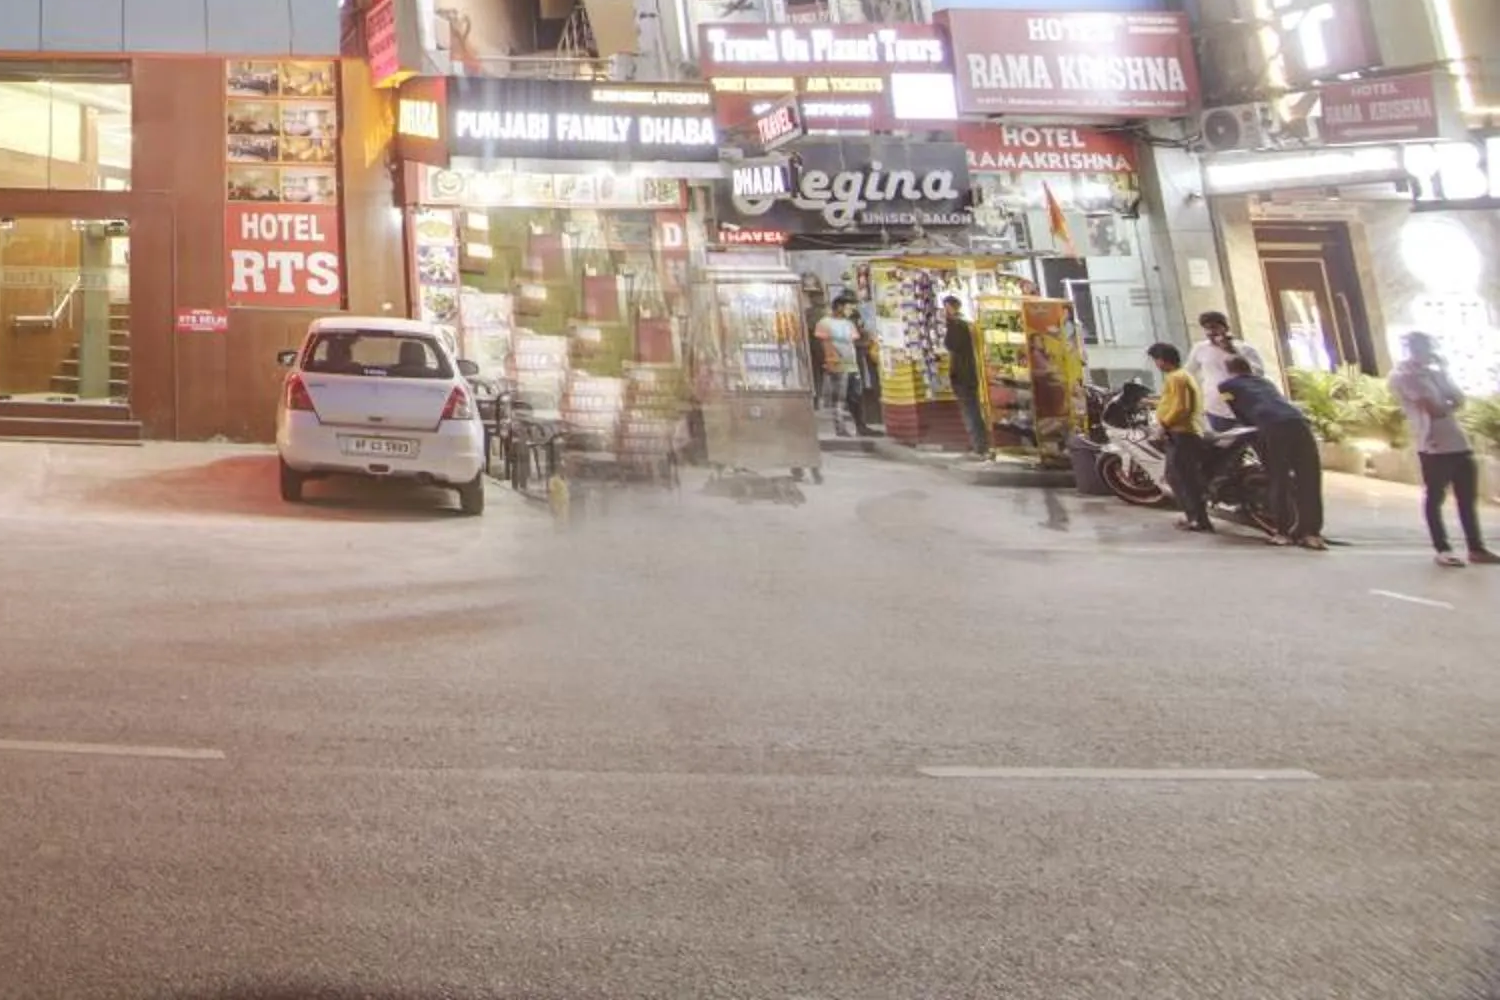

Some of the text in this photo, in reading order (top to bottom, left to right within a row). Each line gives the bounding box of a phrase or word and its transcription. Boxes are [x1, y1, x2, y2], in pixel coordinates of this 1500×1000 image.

[707, 28, 779, 62] Travel
[780, 28, 810, 62] On
[879, 29, 943, 62] Tours
[967, 53, 1188, 93] RAMA KRISHNA
[1367, 98, 1433, 122] KRISHNA
[456, 110, 549, 139] PUNJABI
[556, 113, 632, 142] FAMILY
[639, 116, 716, 145] DHABA
[1002, 126, 1086, 148] HOTEL
[967, 150, 1132, 172] RAMAKRISHNA
[733, 165, 785, 195] DHABA
[240, 212, 325, 242] HOTEL
[923, 214, 972, 226] SALON
[231, 249, 340, 296] RTS
